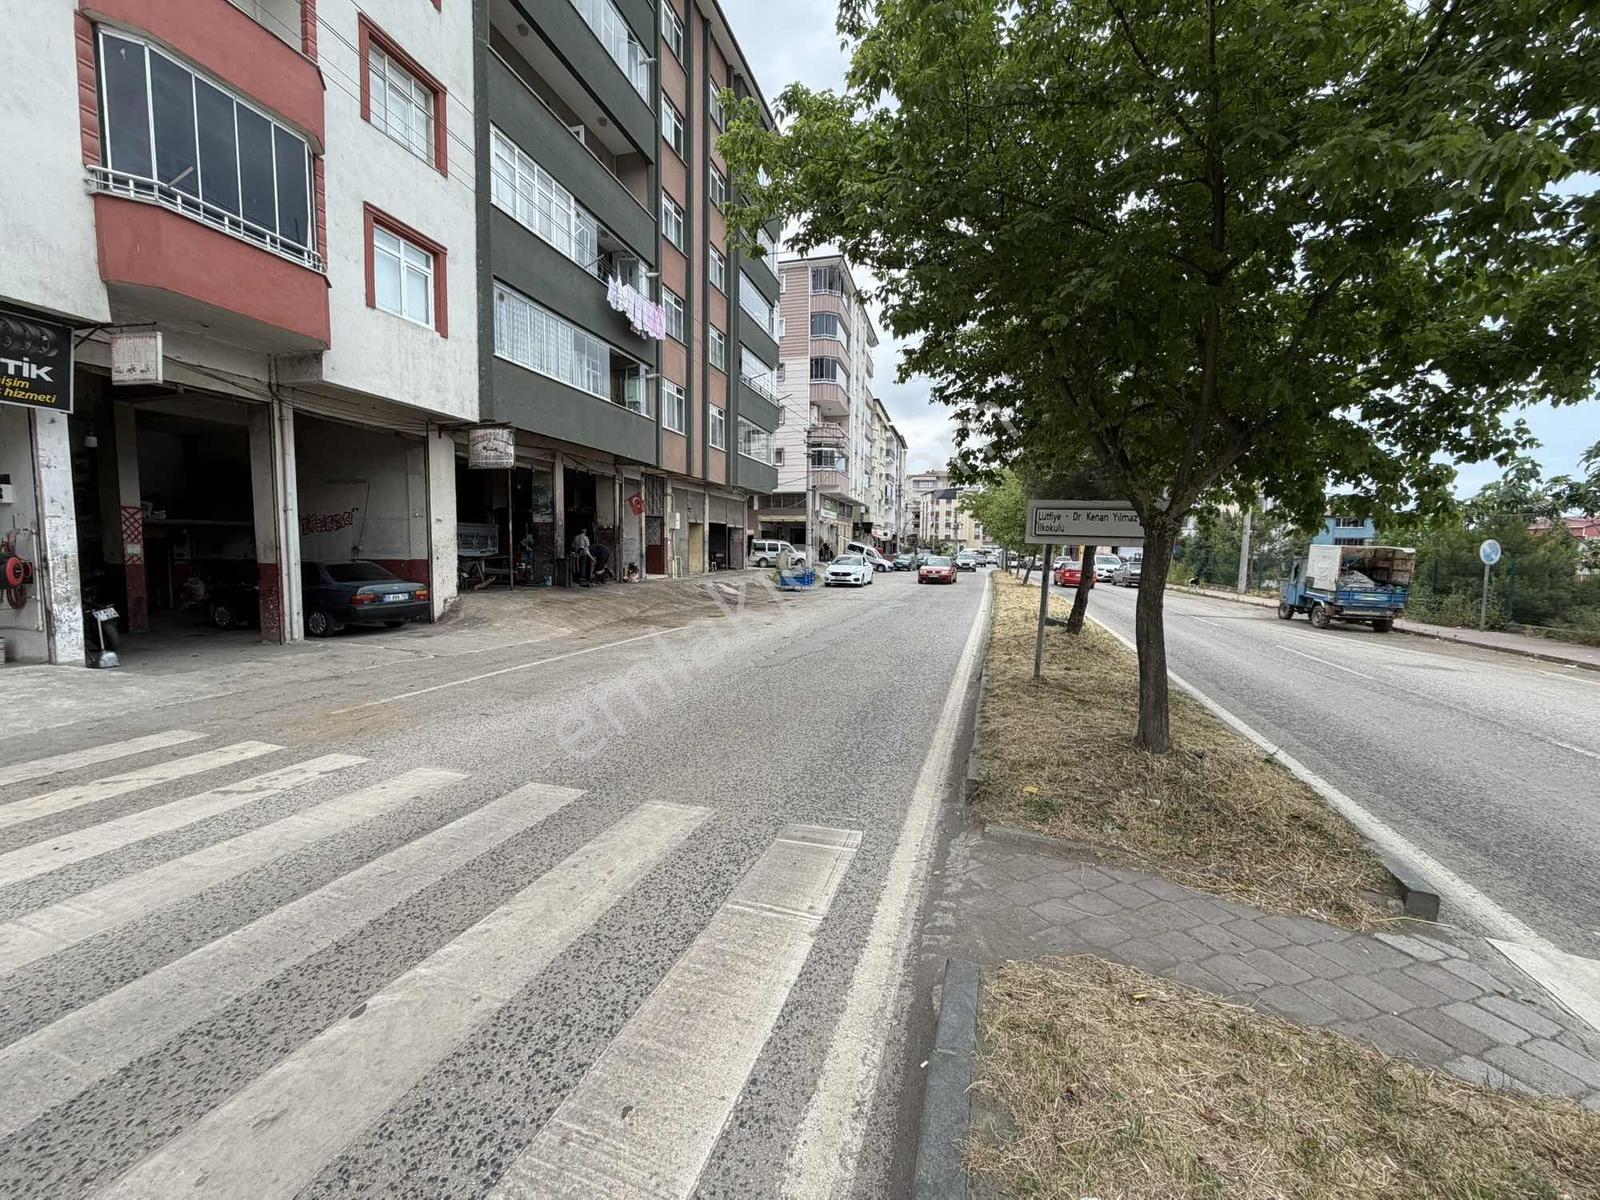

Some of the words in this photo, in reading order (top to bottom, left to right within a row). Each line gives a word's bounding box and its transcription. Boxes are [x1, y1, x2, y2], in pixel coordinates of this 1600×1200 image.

[0, 356, 54, 383] TİK
[0, 375, 30, 389] işim
[4, 386, 57, 404] hizmeti
[1086, 512, 1109, 522] Kenan
[1112, 512, 1138, 522] Yılmaz
